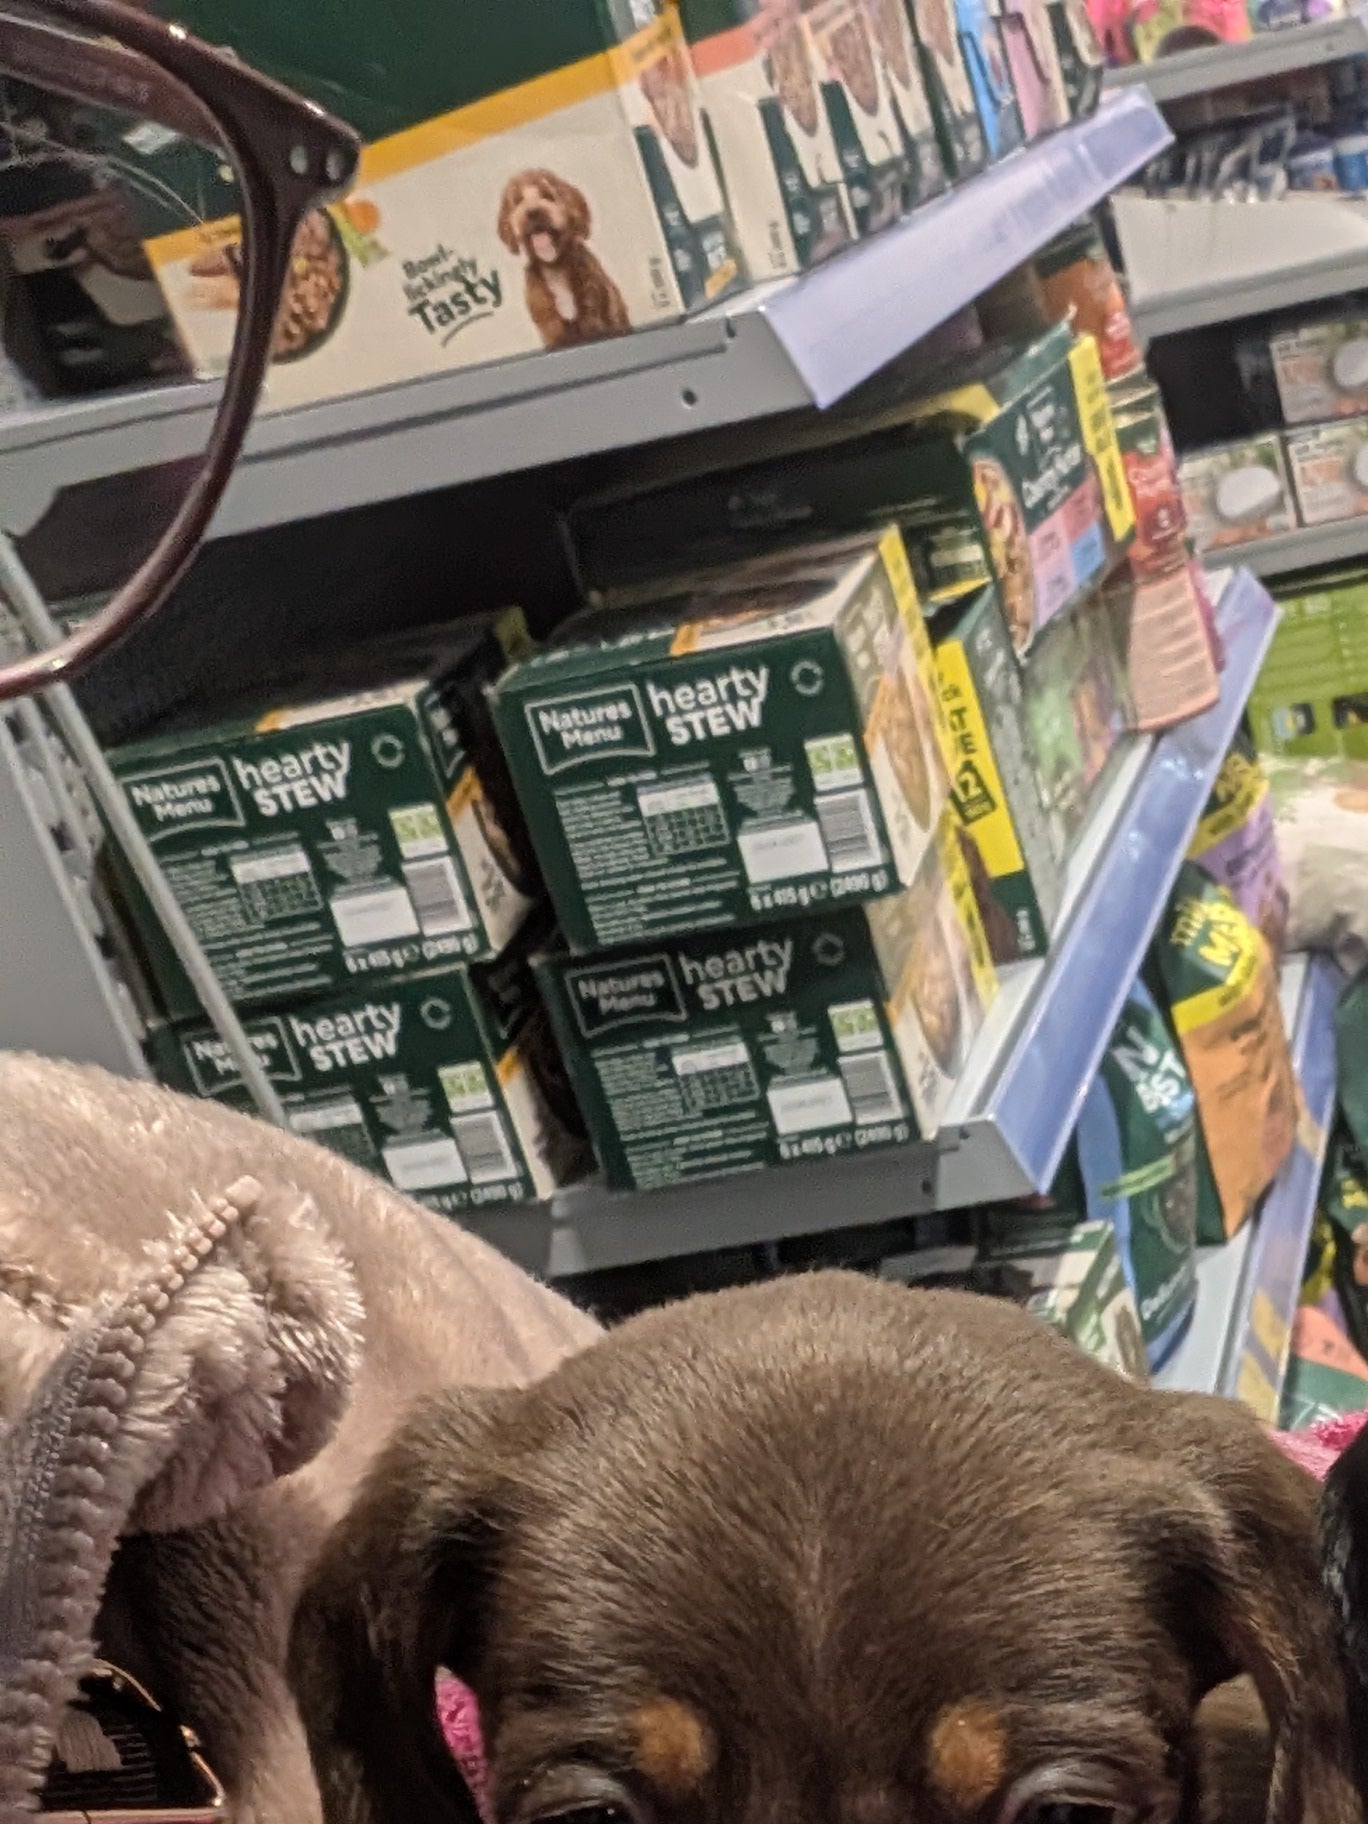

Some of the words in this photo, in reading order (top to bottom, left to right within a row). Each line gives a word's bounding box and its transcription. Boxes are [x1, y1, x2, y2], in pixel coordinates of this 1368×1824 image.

[408, 269, 502, 334] Tasty
[646, 665, 770, 717] hearty
[538, 701, 633, 735] Natures
[561, 724, 625, 749] Menu
[665, 701, 763, 745] STEW
[232, 741, 350, 789] hearty
[131, 774, 221, 806] Natures
[155, 798, 215, 822] Menu
[254, 772, 347, 816] STEW
[679, 937, 793, 984] hearty
[577, 970, 666, 999] Natures
[599, 993, 657, 1015] Menu
[697, 968, 787, 1010] STEW
[288, 1003, 401, 1046] hearty
[310, 1031, 396, 1071] STEW
